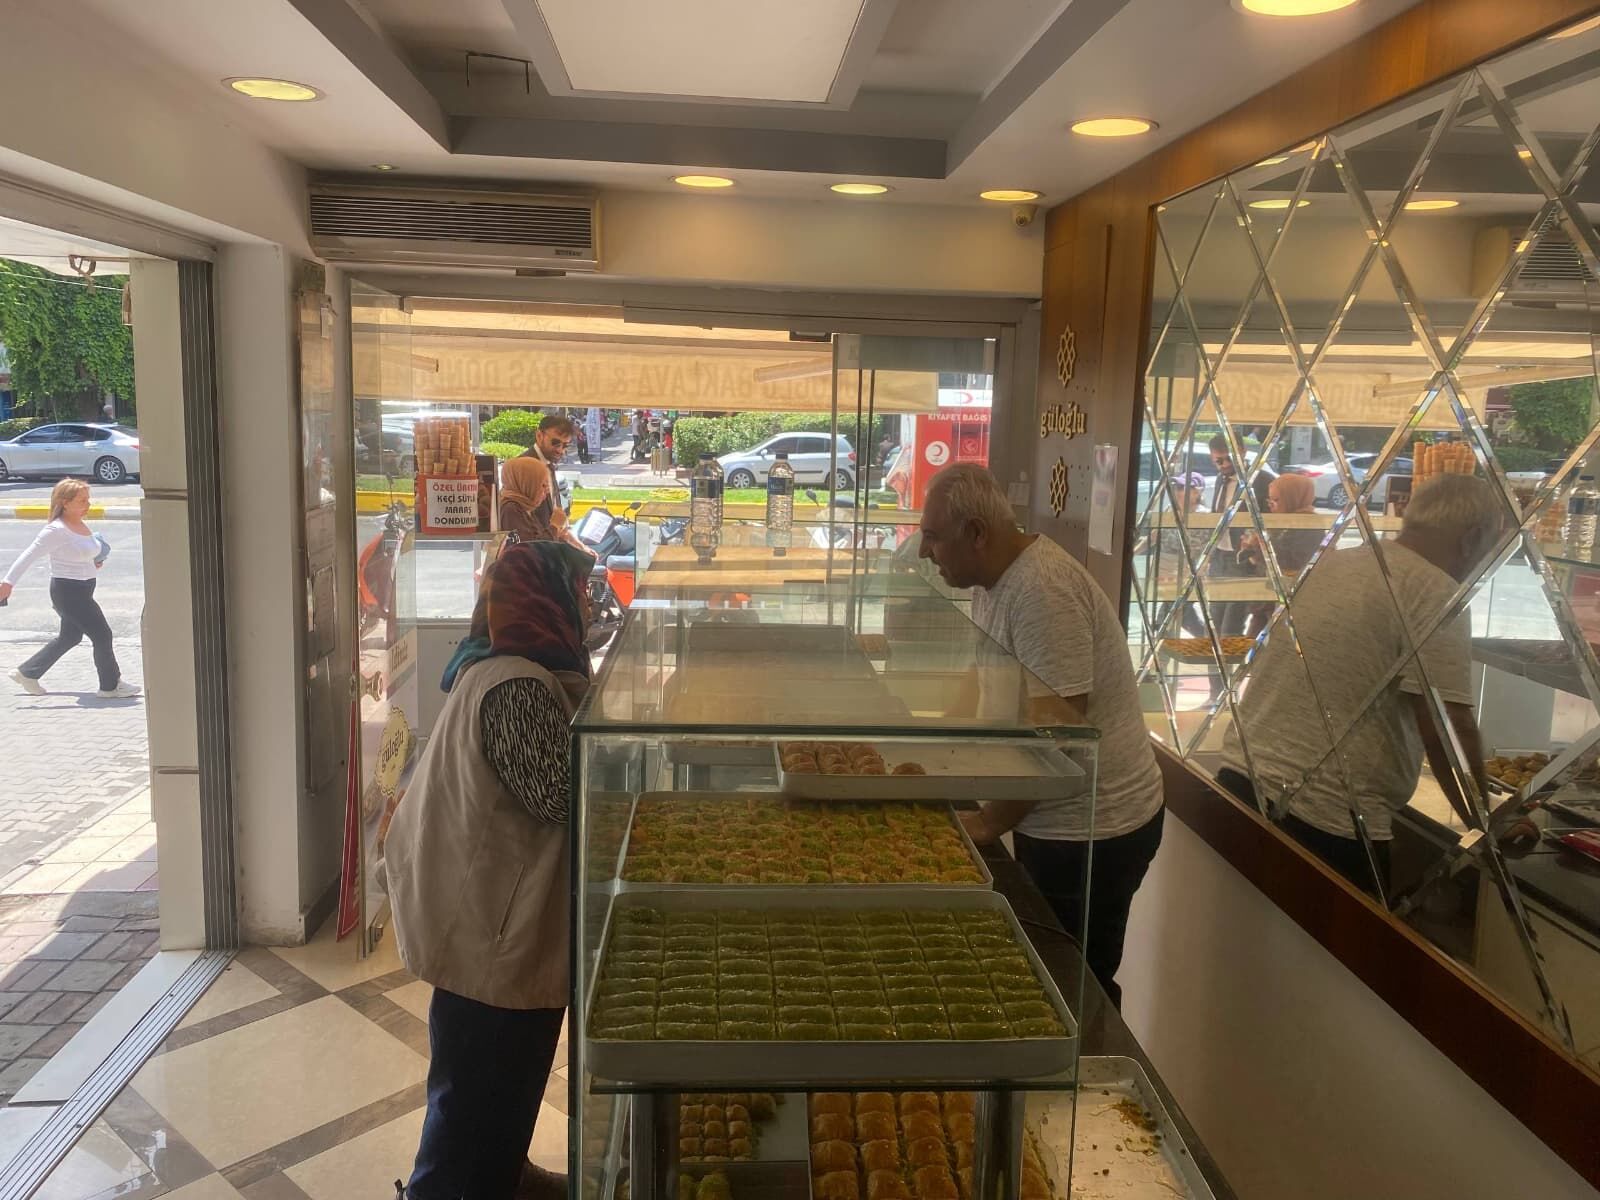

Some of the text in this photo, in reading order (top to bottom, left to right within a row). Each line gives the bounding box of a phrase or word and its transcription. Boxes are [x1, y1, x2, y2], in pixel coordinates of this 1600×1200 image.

[1040, 401, 1086, 440] güloğlu
[432, 481, 454, 491] ÖZEL
[437, 494, 456, 505] KEÇİ
[381, 728, 405, 773] güloğlu
